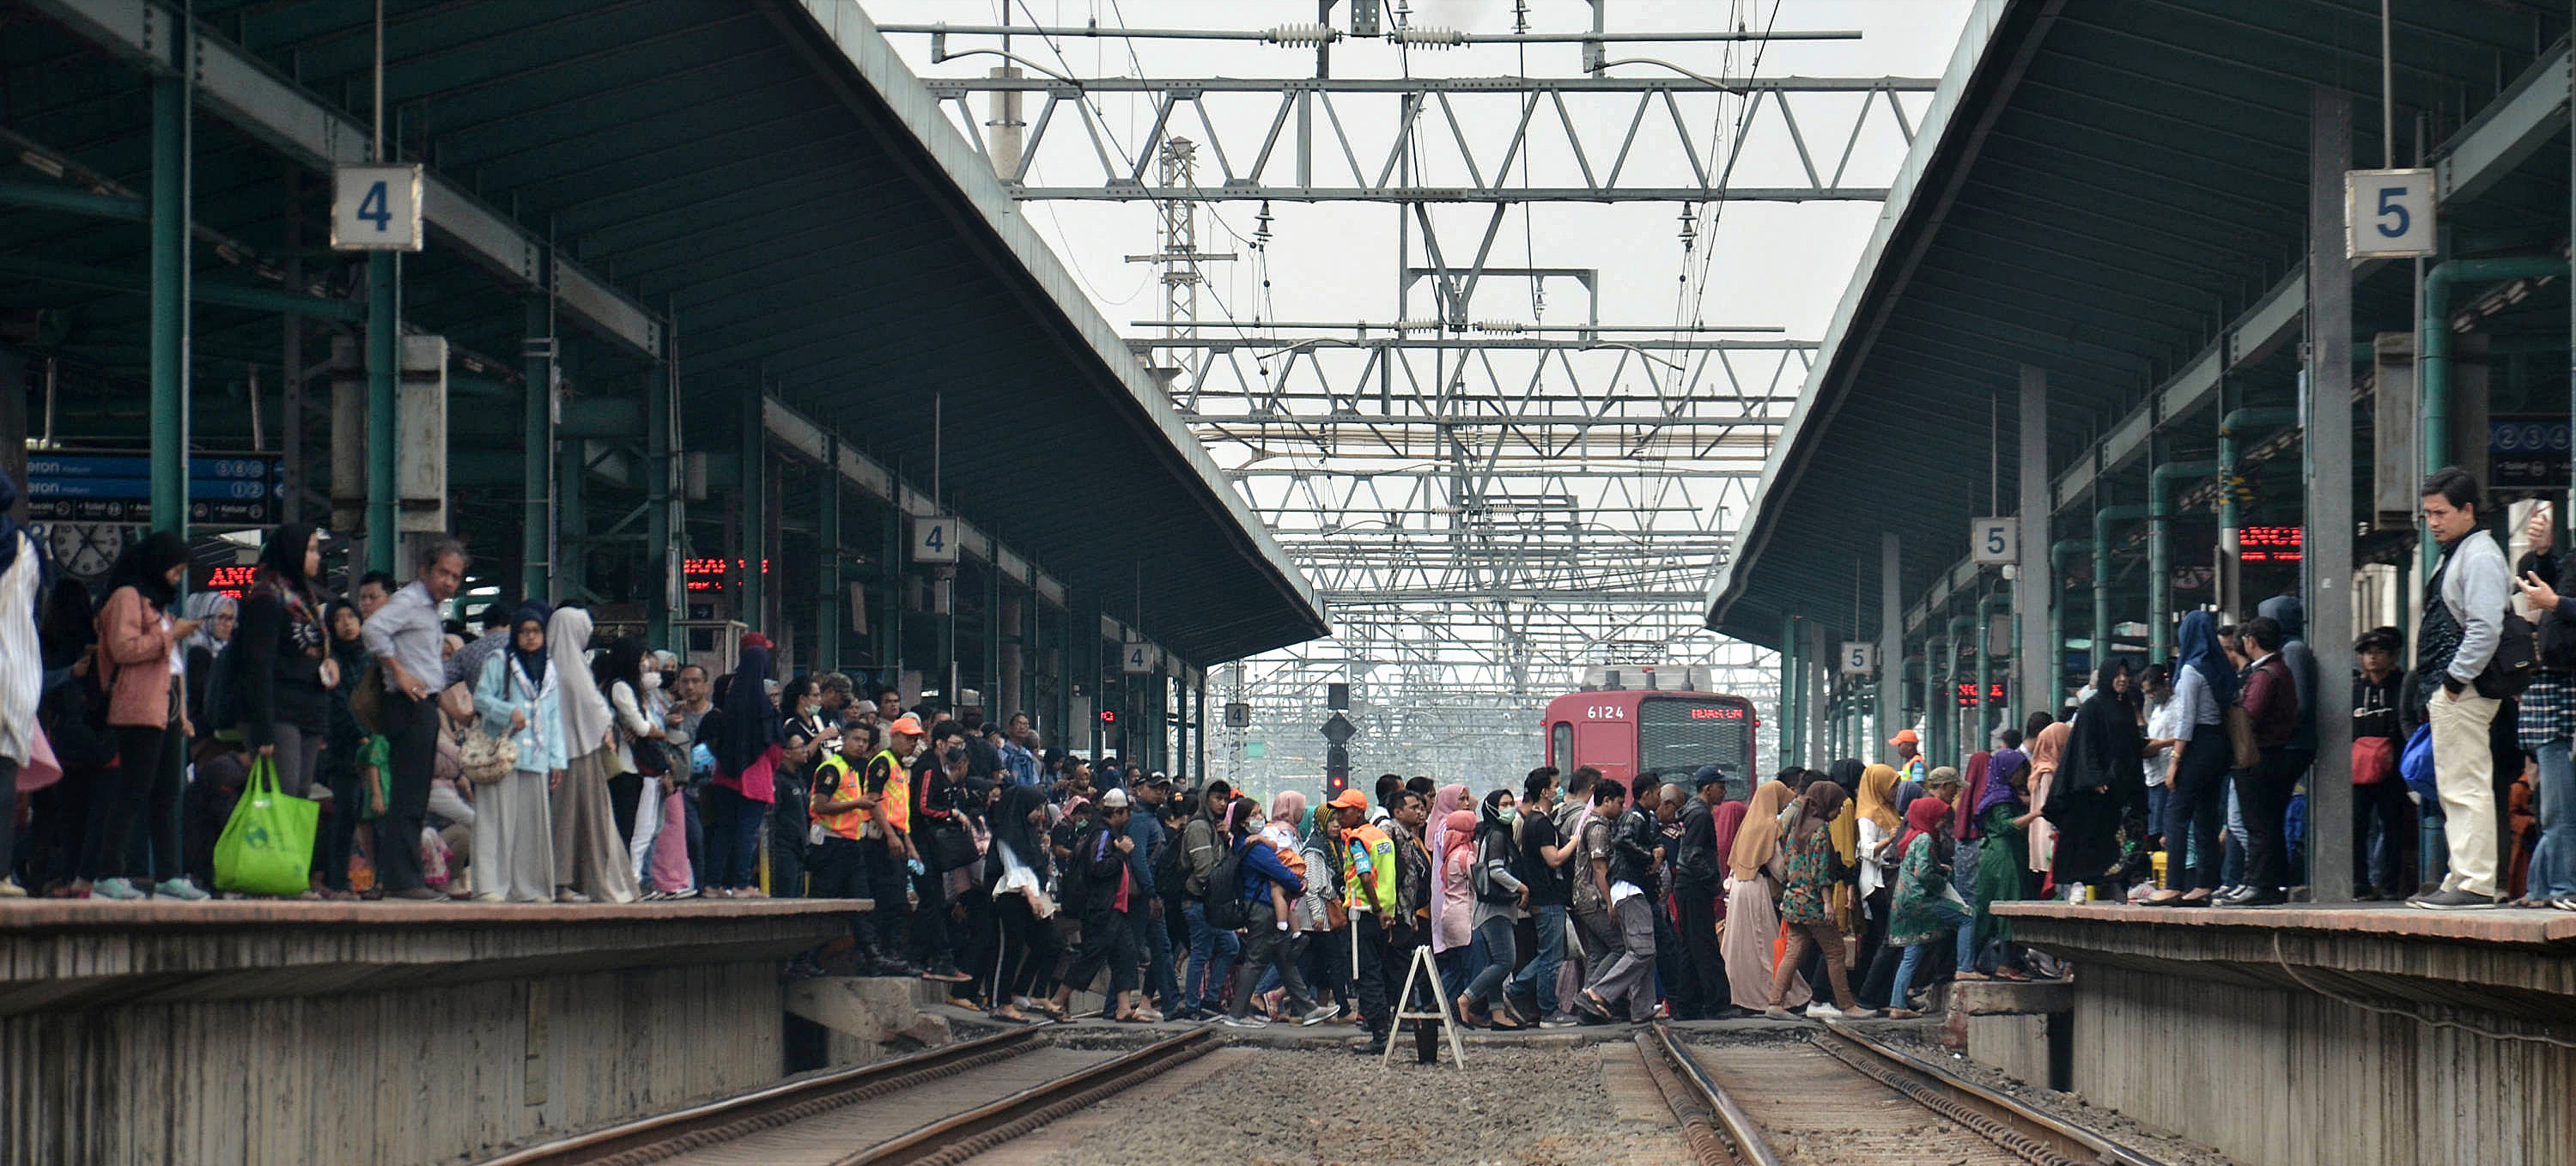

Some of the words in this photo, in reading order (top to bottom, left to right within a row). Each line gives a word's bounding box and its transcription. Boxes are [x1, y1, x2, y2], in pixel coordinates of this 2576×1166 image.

[357, 181, 392, 232] 4
[2377, 186, 2410, 238] 5
[27, 461, 60, 473] eron
[27, 482, 59, 493] eron
[926, 525, 944, 552] 4
[1988, 527, 2006, 554] 5
[1131, 648, 1143, 666] 4
[1851, 648, 1864, 667] 5
[1231, 708, 1242, 722] 4
[1587, 705, 1625, 719] 6124
